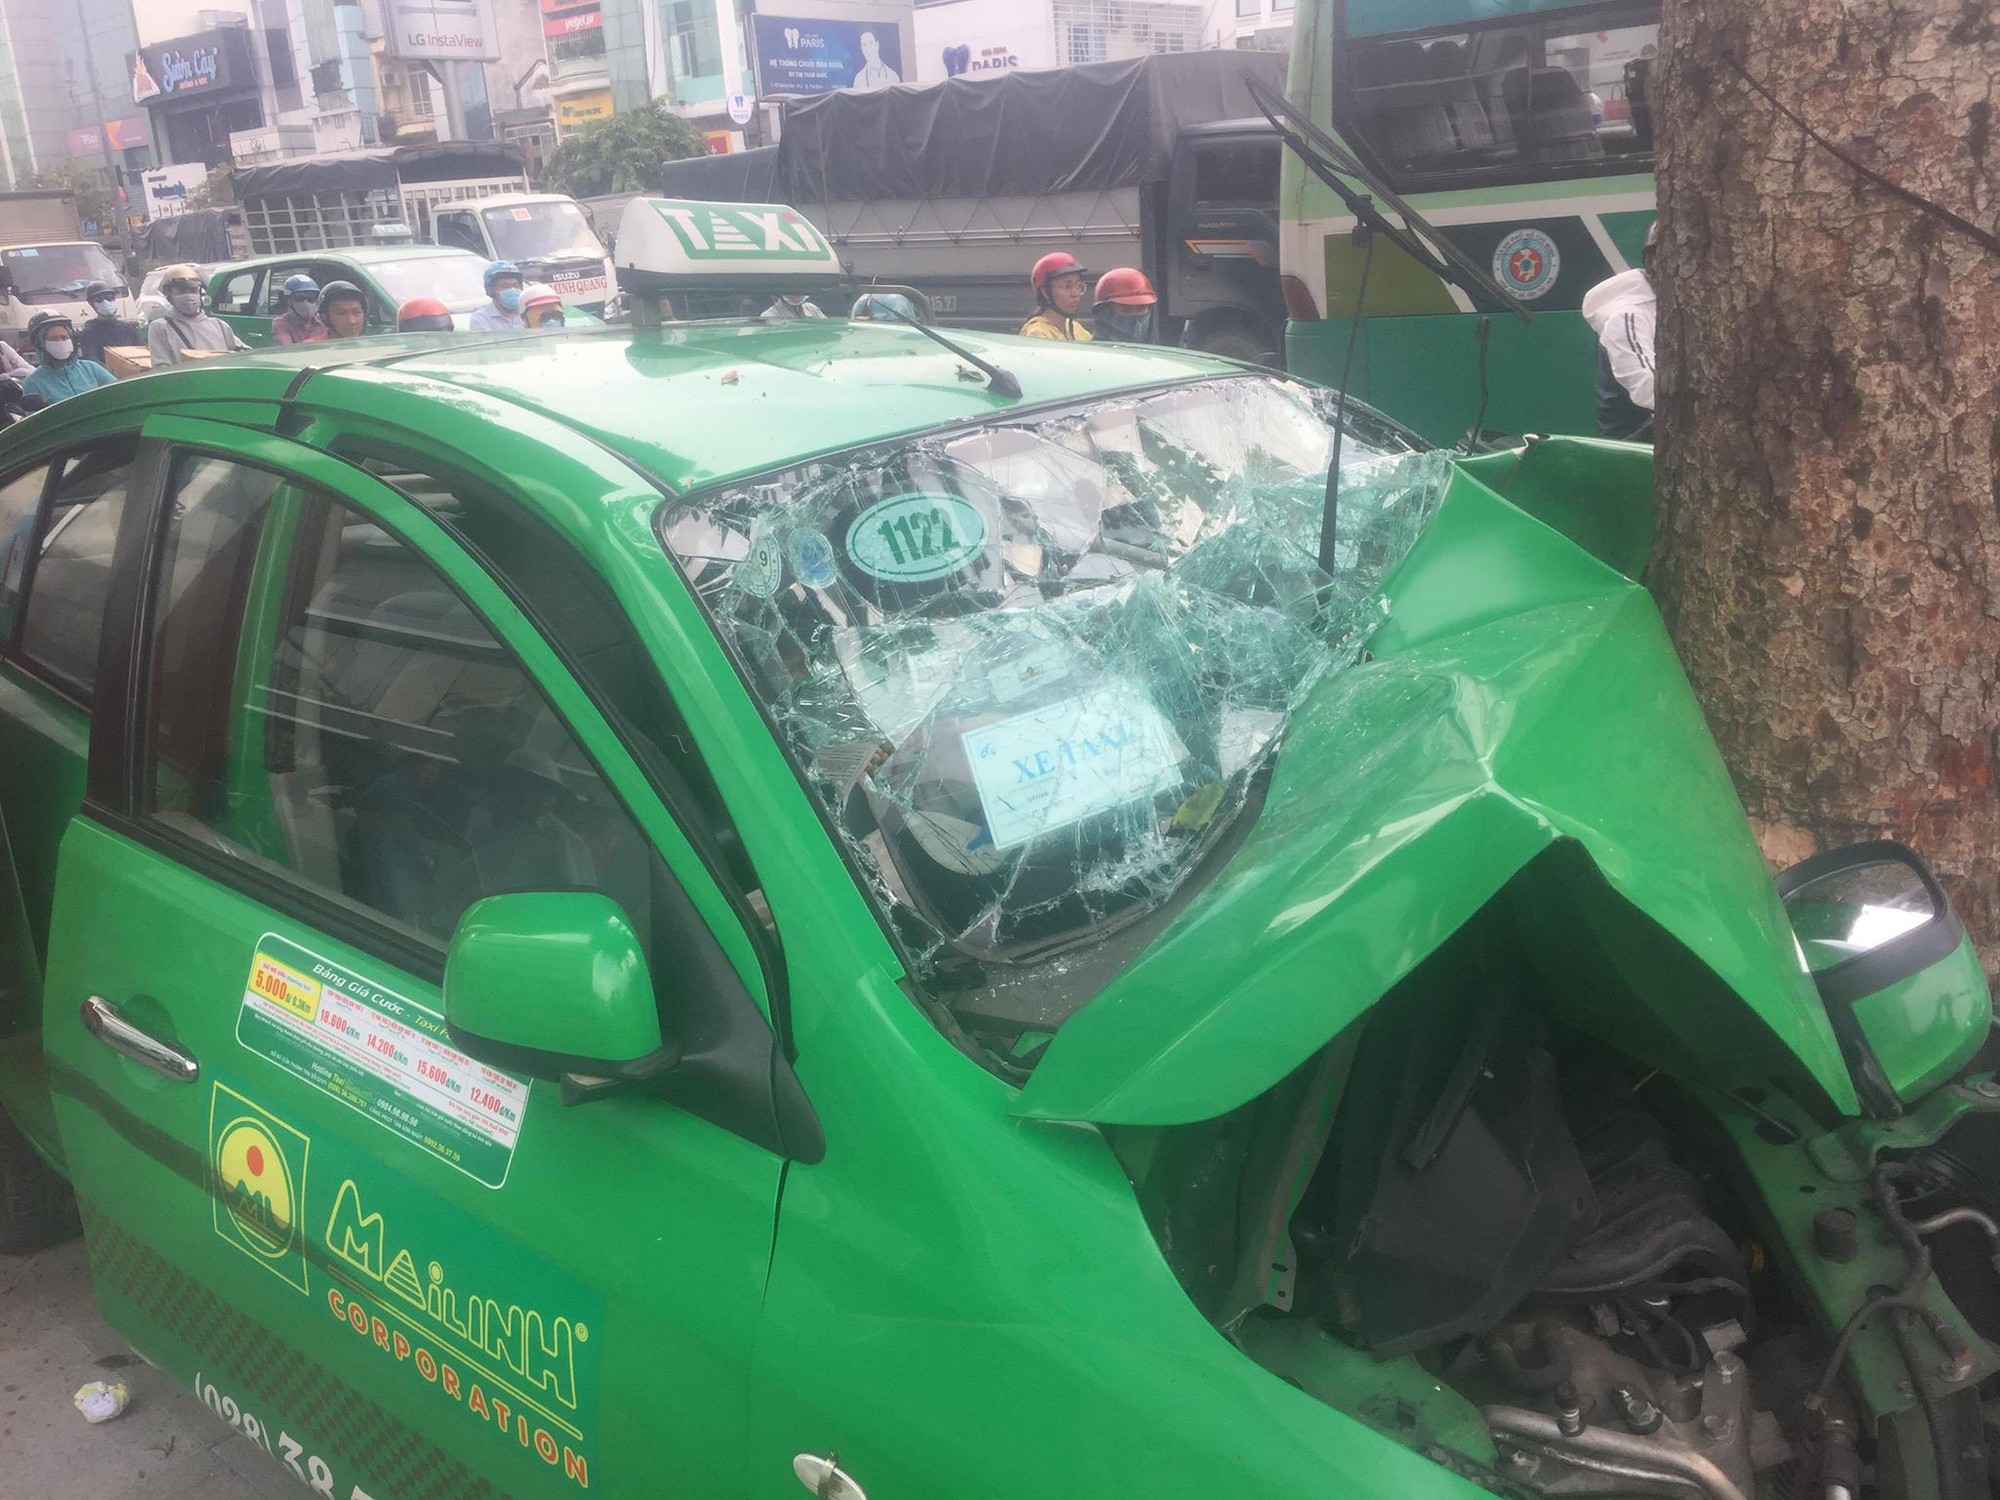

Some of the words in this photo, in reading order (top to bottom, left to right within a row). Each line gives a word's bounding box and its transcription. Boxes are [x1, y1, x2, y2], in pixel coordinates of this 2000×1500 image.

[408, 33, 426, 47] LG
[427, 33, 484, 48] InstaView
[800, 38, 825, 49] PARIS
[552, 271, 580, 281] ISUZU
[576, 277, 608, 296] QUANG
[876, 507, 960, 565] 1122
[1011, 749, 1056, 784] XE
[312, 964, 347, 988] Bảng
[347, 981, 370, 998] Giá
[415, 1015, 439, 1033] Taxi
[311, 1061, 333, 1079] Hotline
[327, 1287, 589, 1489] CORPORATION
